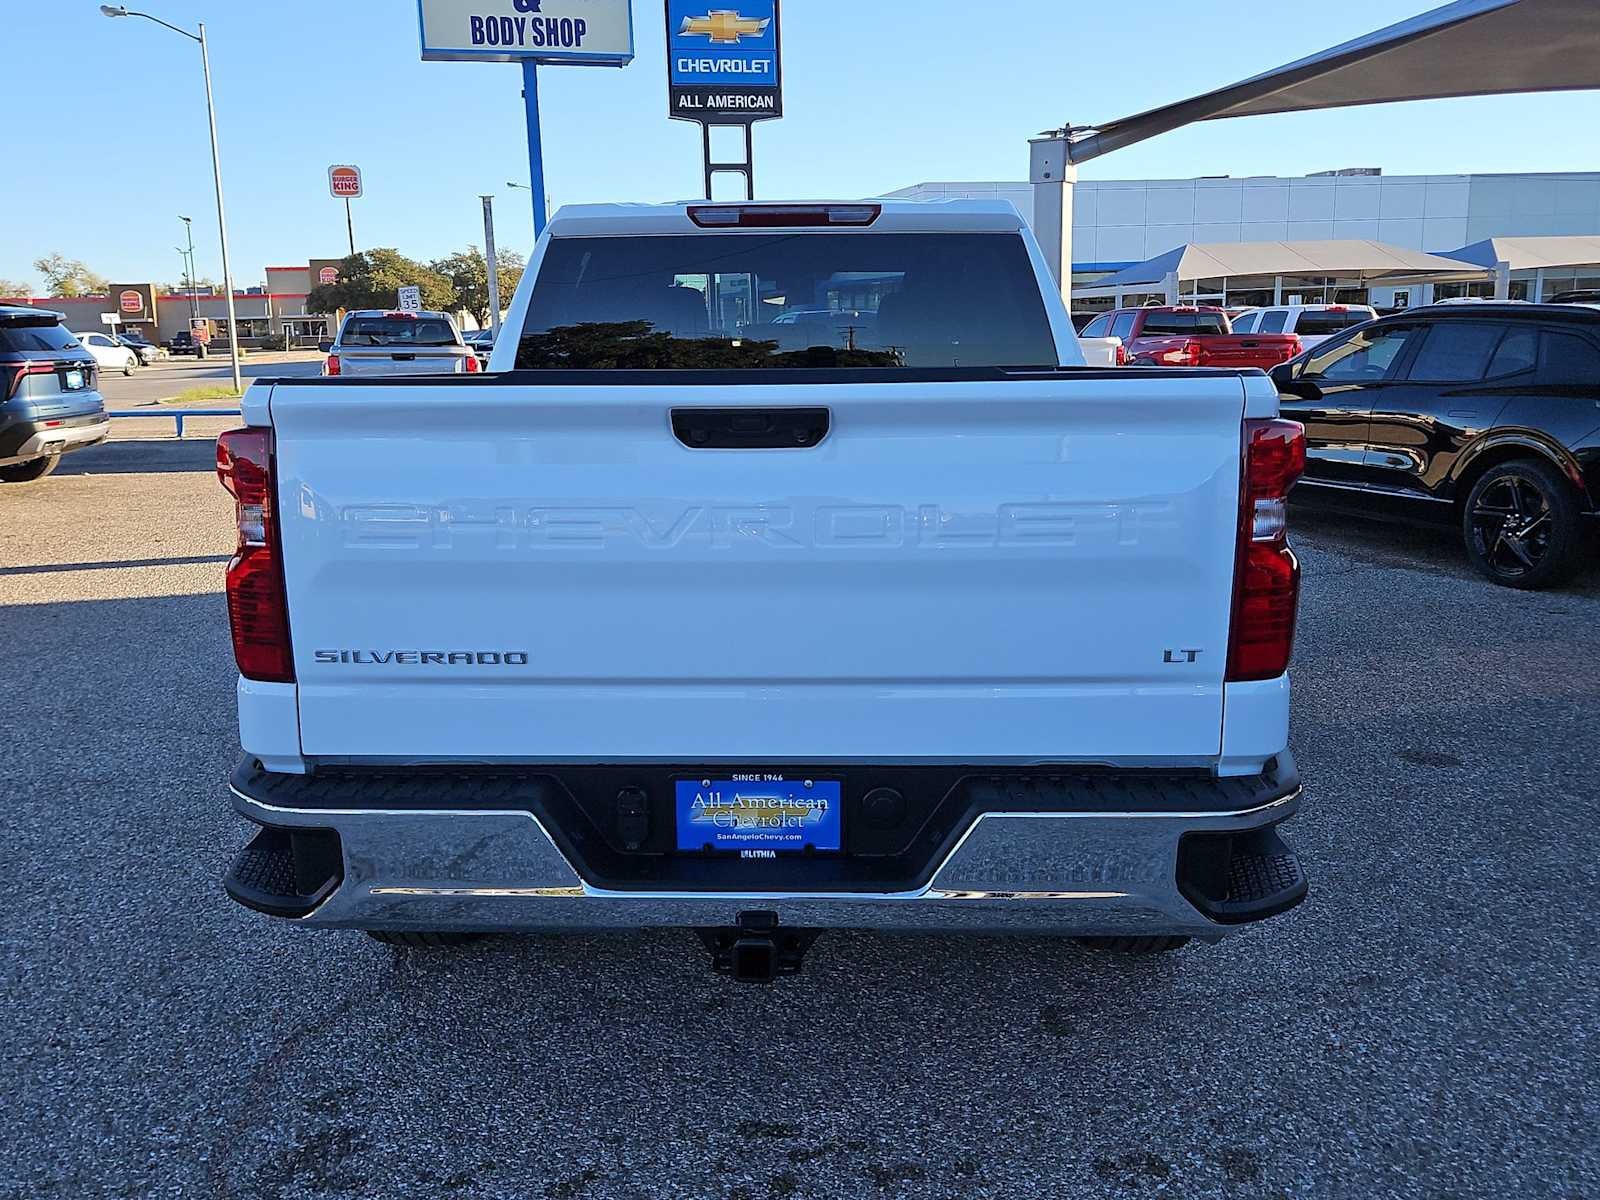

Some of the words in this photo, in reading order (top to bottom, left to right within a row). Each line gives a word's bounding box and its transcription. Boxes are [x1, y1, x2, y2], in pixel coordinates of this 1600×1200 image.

[470, 15, 526, 46] BODY
[531, 17, 586, 47] SHOP
[677, 58, 771, 73] CHEVROLET
[679, 95, 703, 108] ALL
[706, 95, 774, 108] AMERICAN
[333, 182, 359, 191] KING
[403, 299, 418, 309] 35
[341, 503, 1174, 549] CHEVROLET
[314, 649, 528, 665] SILVERADO
[1163, 649, 1203, 663] LT
[732, 774, 761, 782] SINCE
[763, 774, 784, 782] 1946
[691, 792, 721, 809] All
[730, 793, 829, 810] American
[713, 811, 805, 828] Chevrolet
[716, 833, 802, 841] SanAngeloChevy.com
